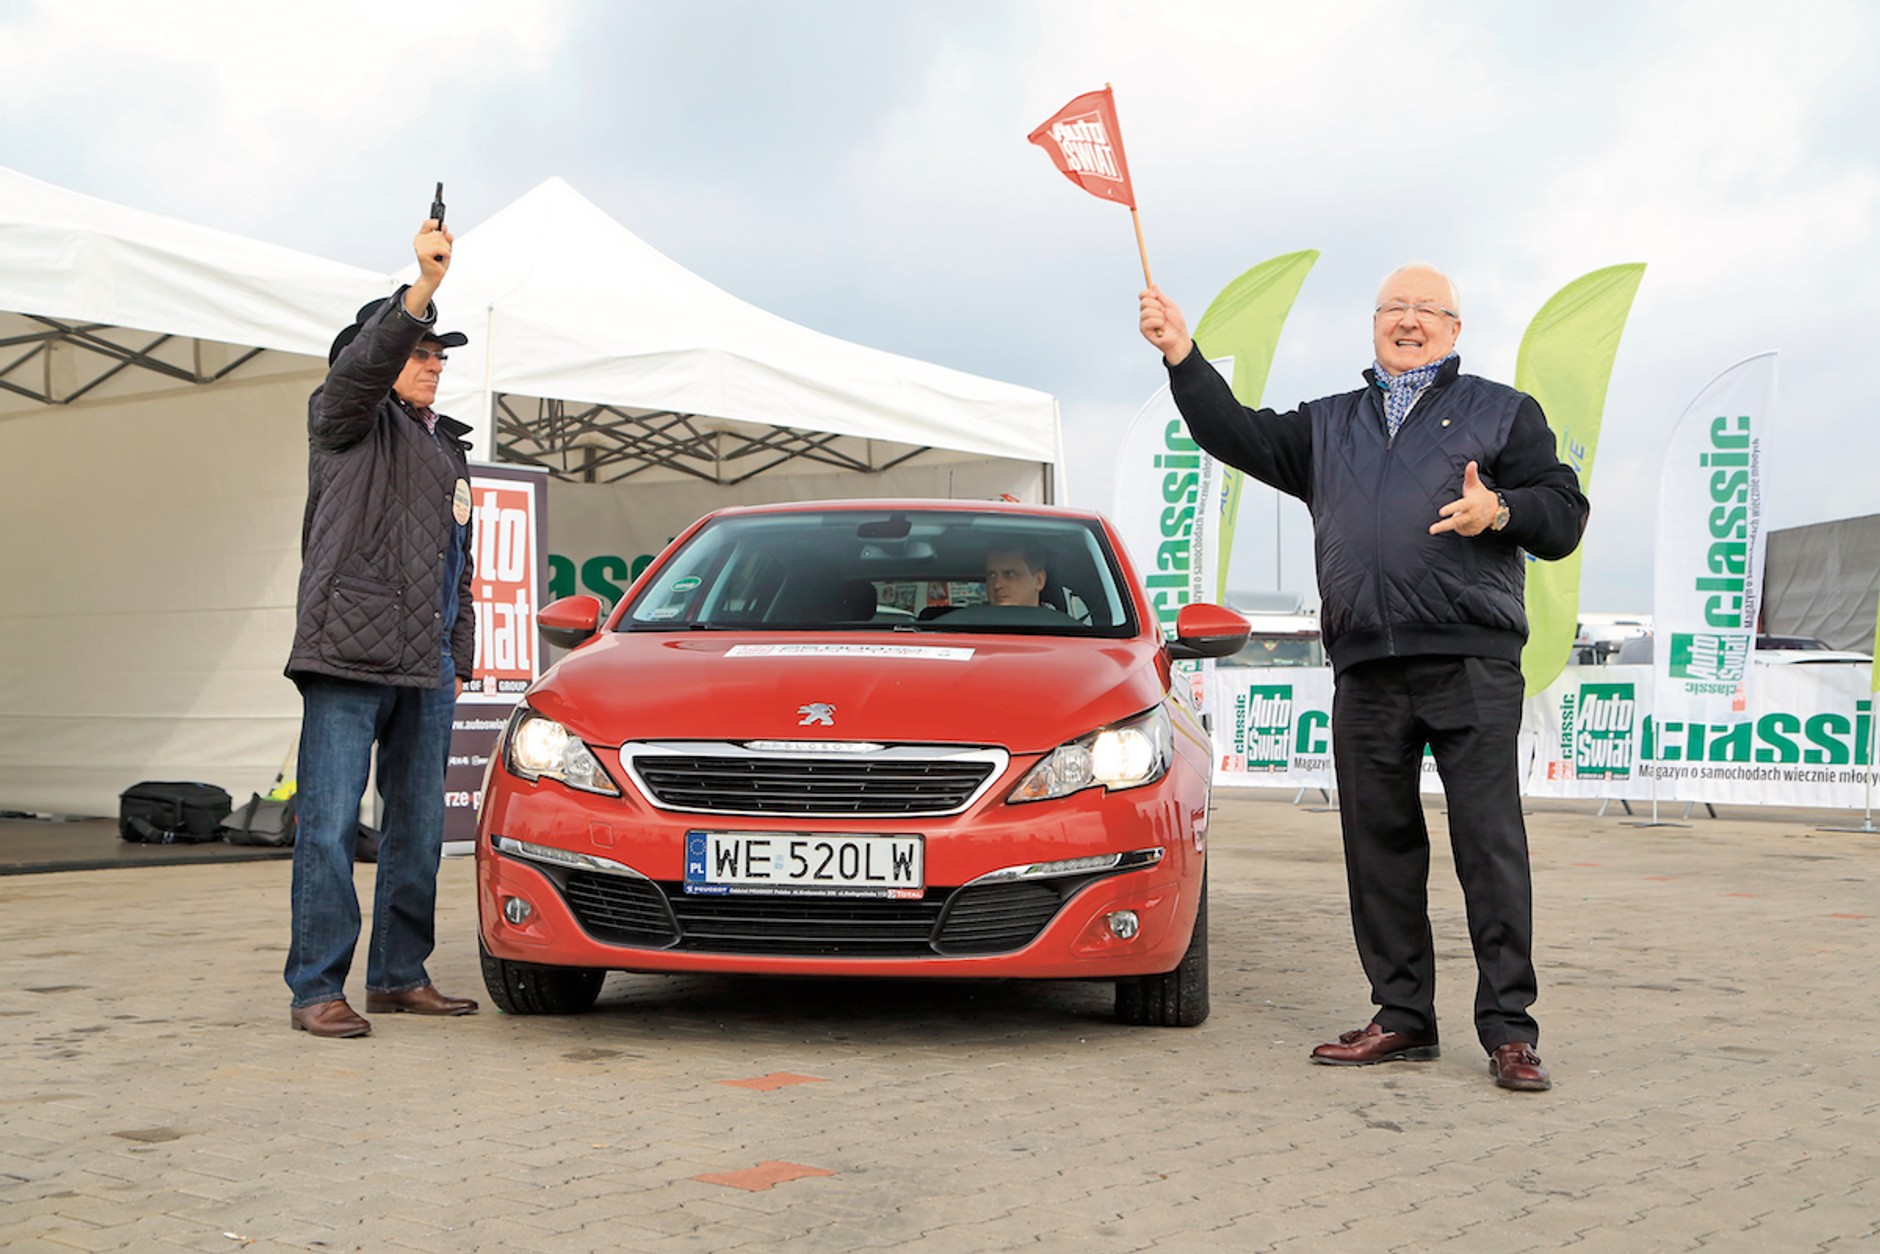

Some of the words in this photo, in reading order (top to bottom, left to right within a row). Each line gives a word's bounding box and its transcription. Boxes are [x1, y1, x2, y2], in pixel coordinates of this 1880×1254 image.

[1695, 415, 1750, 628] classic
[1234, 694, 1246, 754] classic
[1248, 692, 1291, 728] Auto
[1560, 693, 1575, 759] classic
[1577, 692, 1634, 731] Auto
[1640, 700, 1880, 766] classi
[1639, 764, 1689, 780] Magazyn
[1690, 769, 1698, 779] o
[1700, 766, 1782, 781] samochodach
[1783, 766, 1836, 783] wiecznie
[690, 862, 705, 875] PL
[715, 839, 771, 878] WE
[789, 841, 914, 882] 520LW
